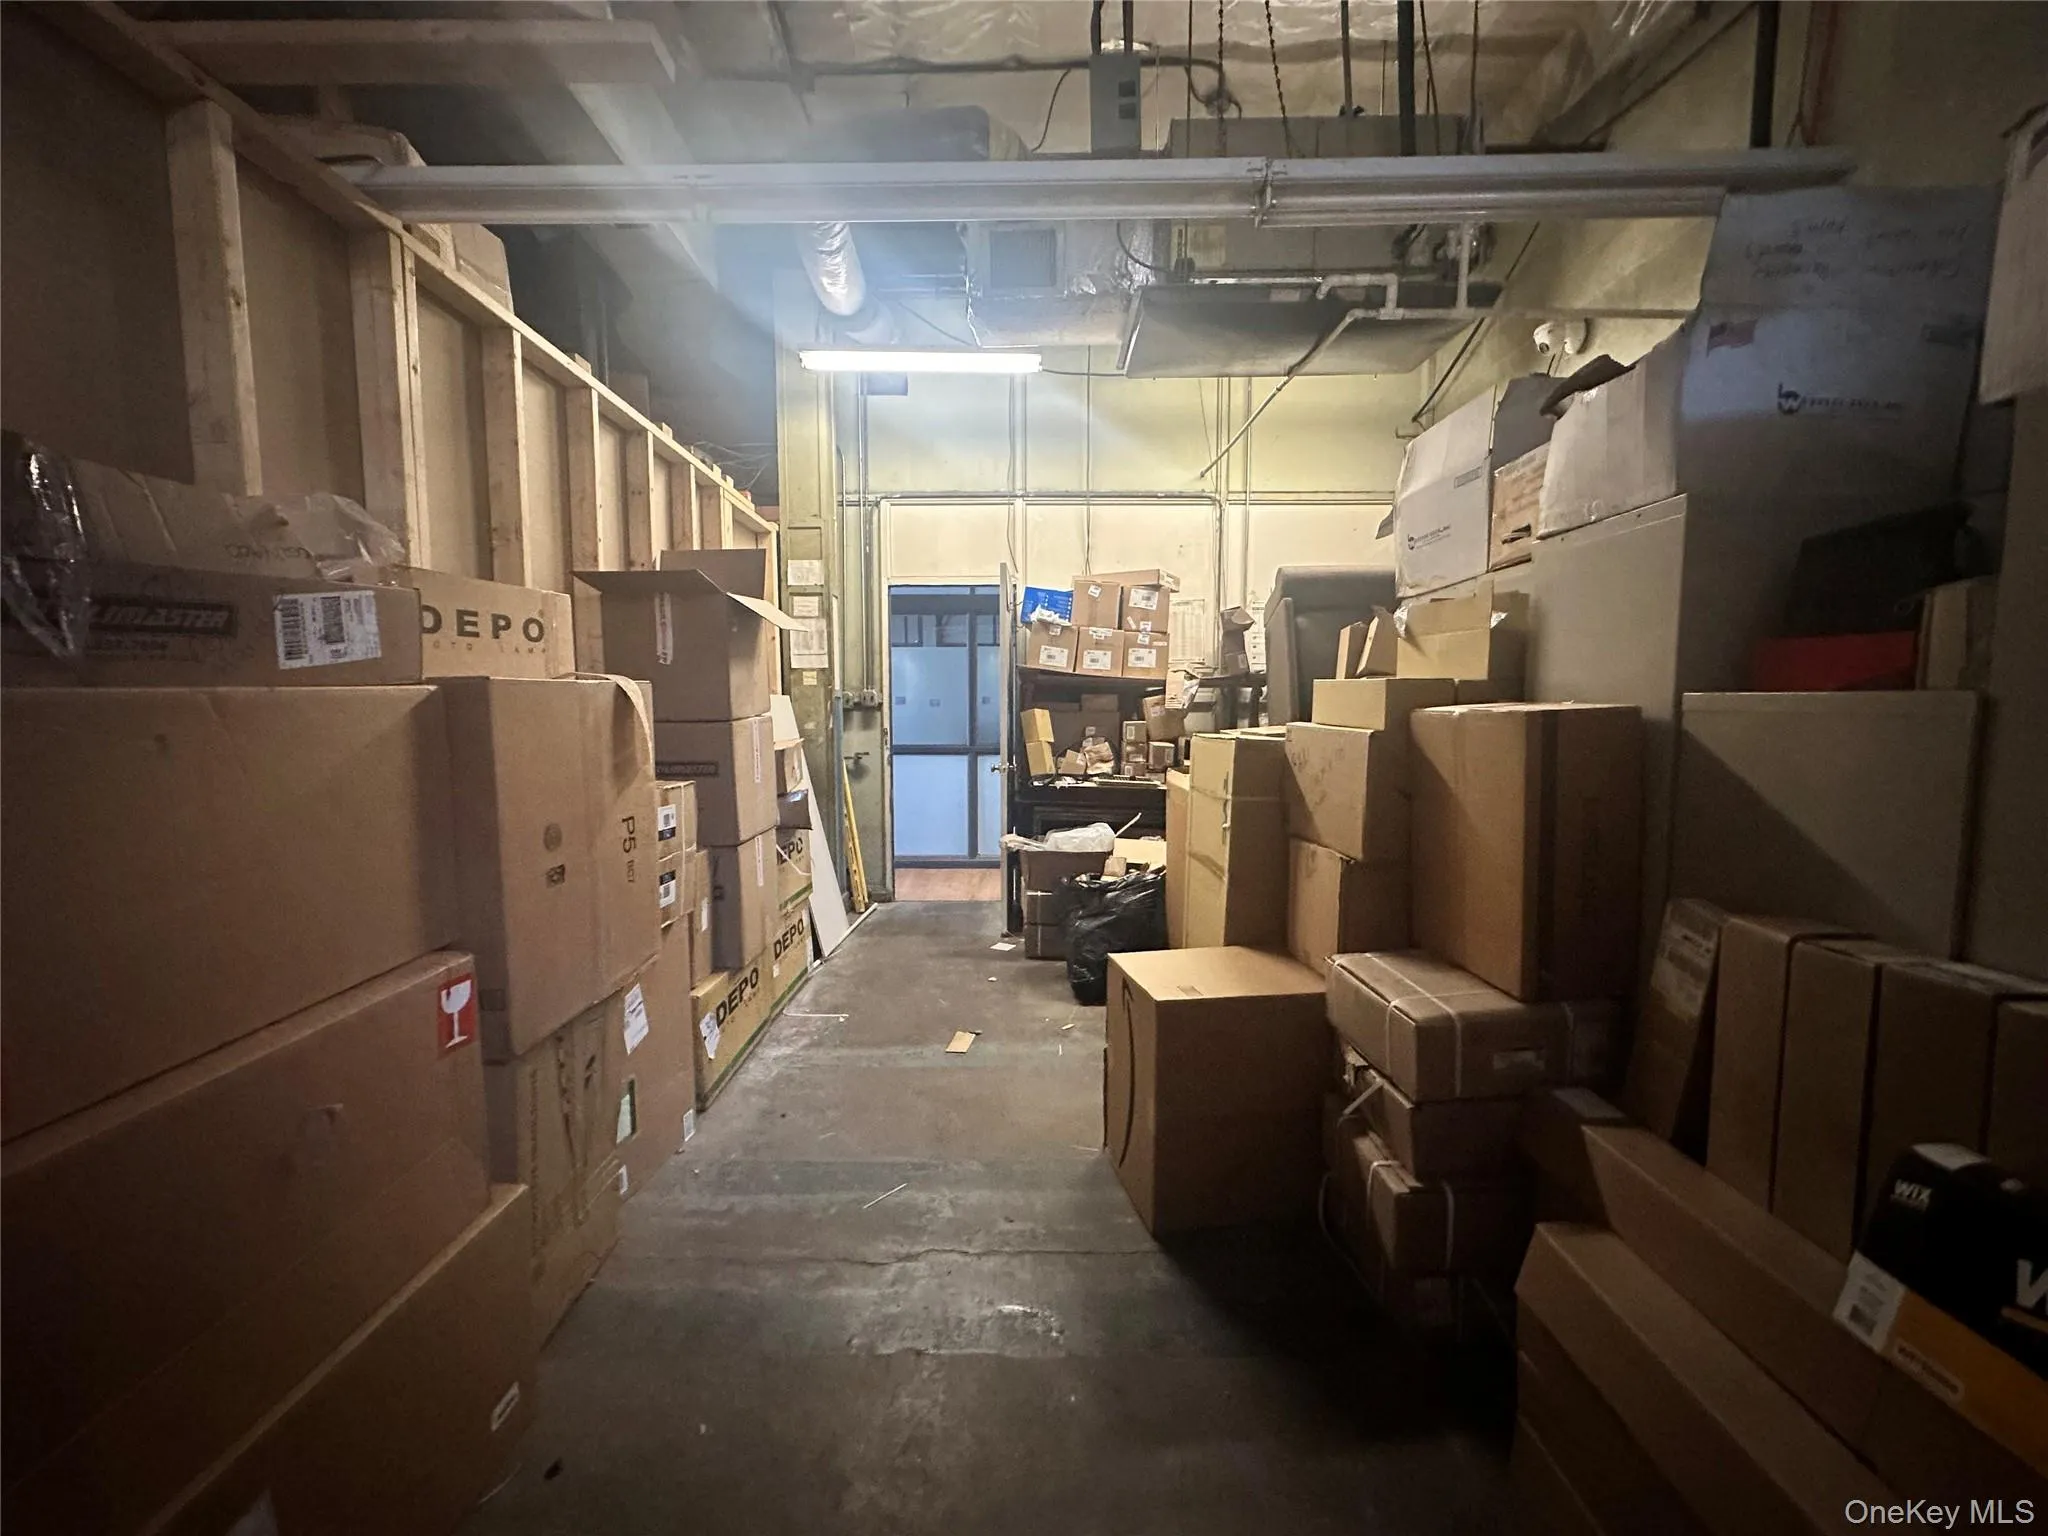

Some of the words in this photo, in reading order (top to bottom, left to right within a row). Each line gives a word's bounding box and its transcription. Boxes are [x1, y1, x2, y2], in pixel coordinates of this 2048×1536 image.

[421, 605, 545, 643] DEPO
[773, 918, 805, 961] DEPO
[715, 967, 759, 1028] DEPO
[1894, 1178, 1933, 1206] WIX
